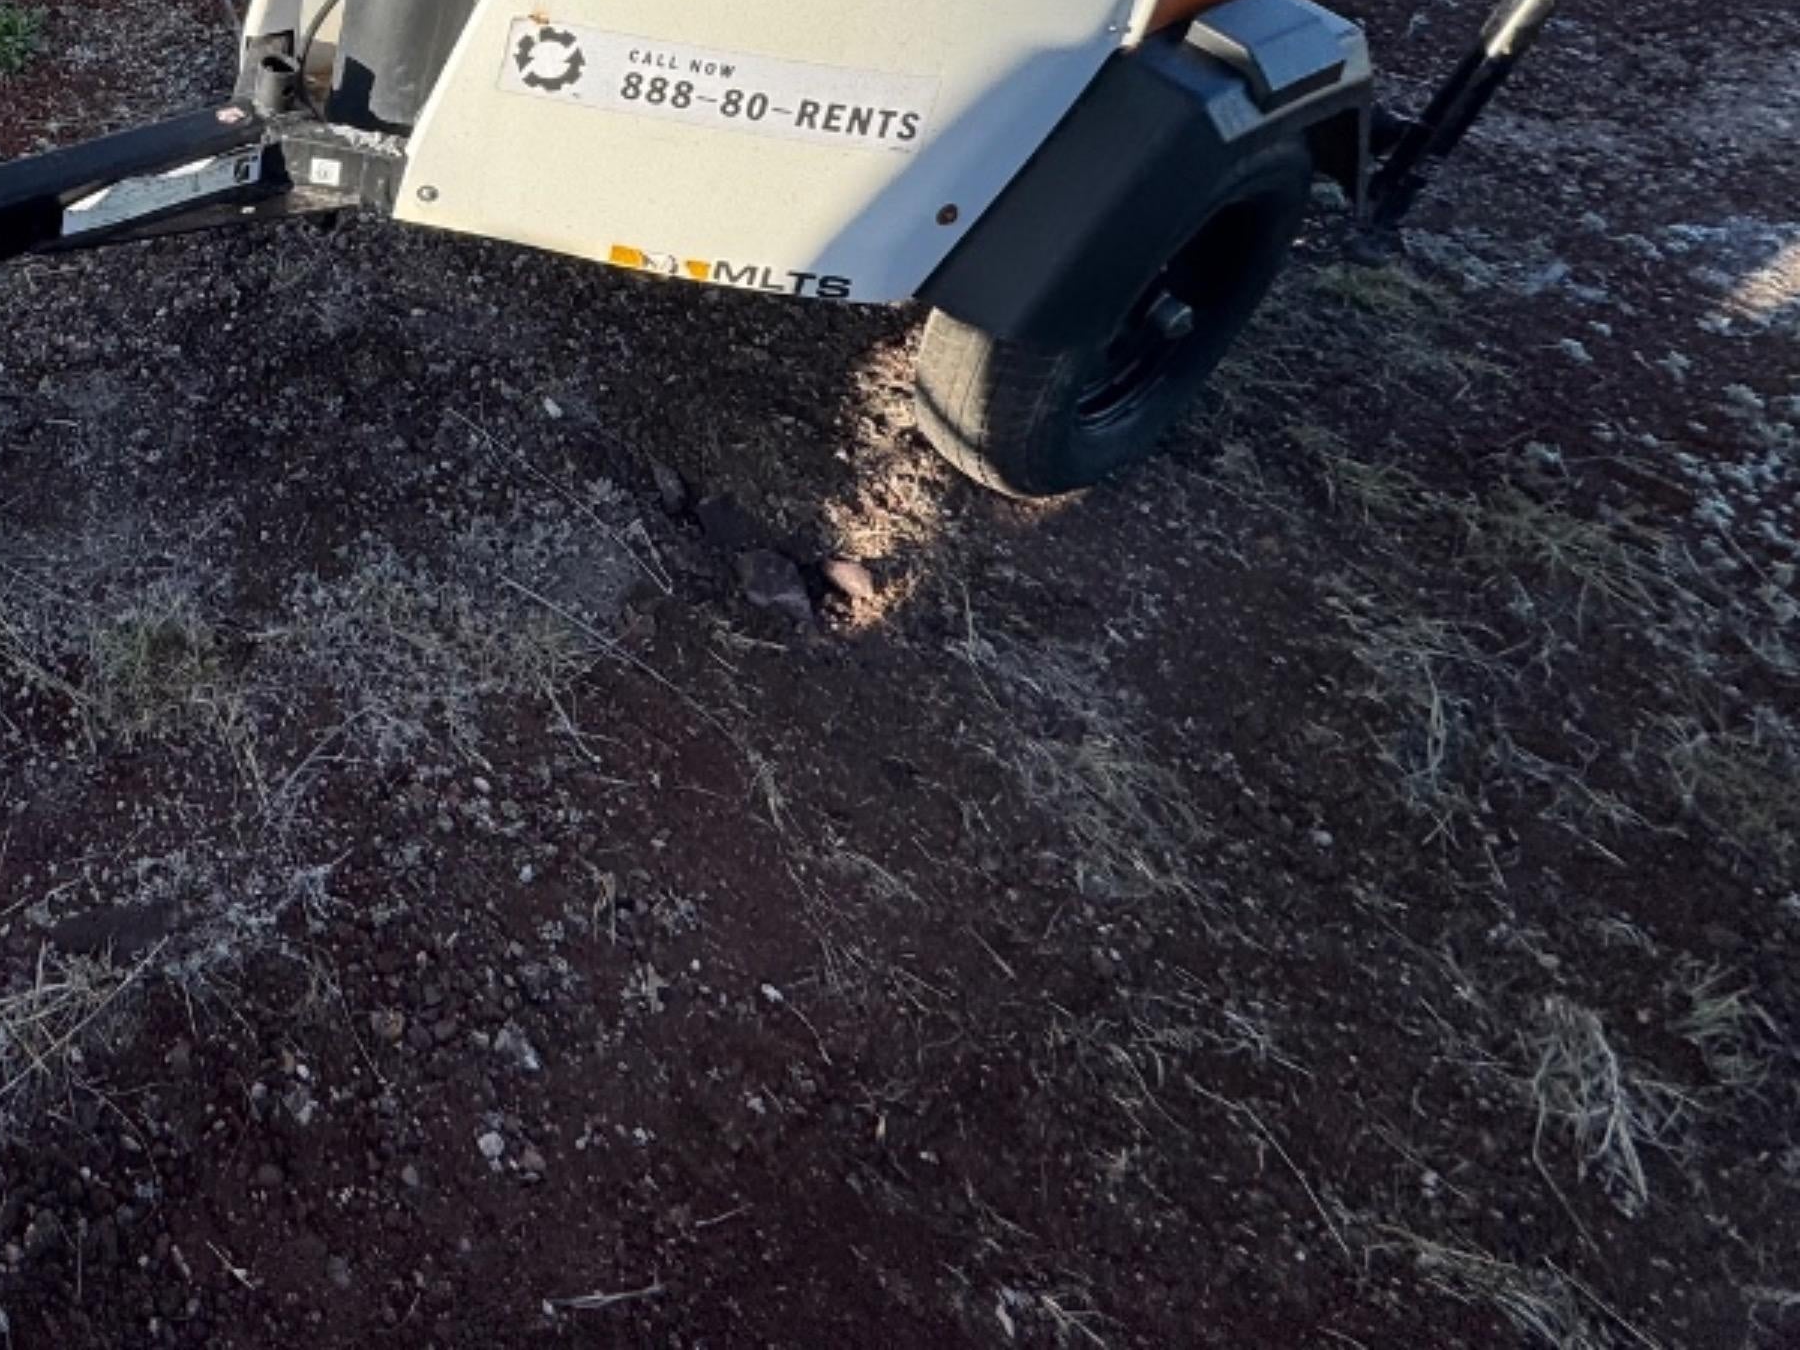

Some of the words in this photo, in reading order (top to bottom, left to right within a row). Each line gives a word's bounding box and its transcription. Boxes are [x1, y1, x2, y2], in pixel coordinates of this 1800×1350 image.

[628, 49, 679, 70] CALL
[689, 61, 737, 80] NOW
[620, 72, 921, 141] 888-80-RENTS
[713, 260, 852, 298] MLTS
